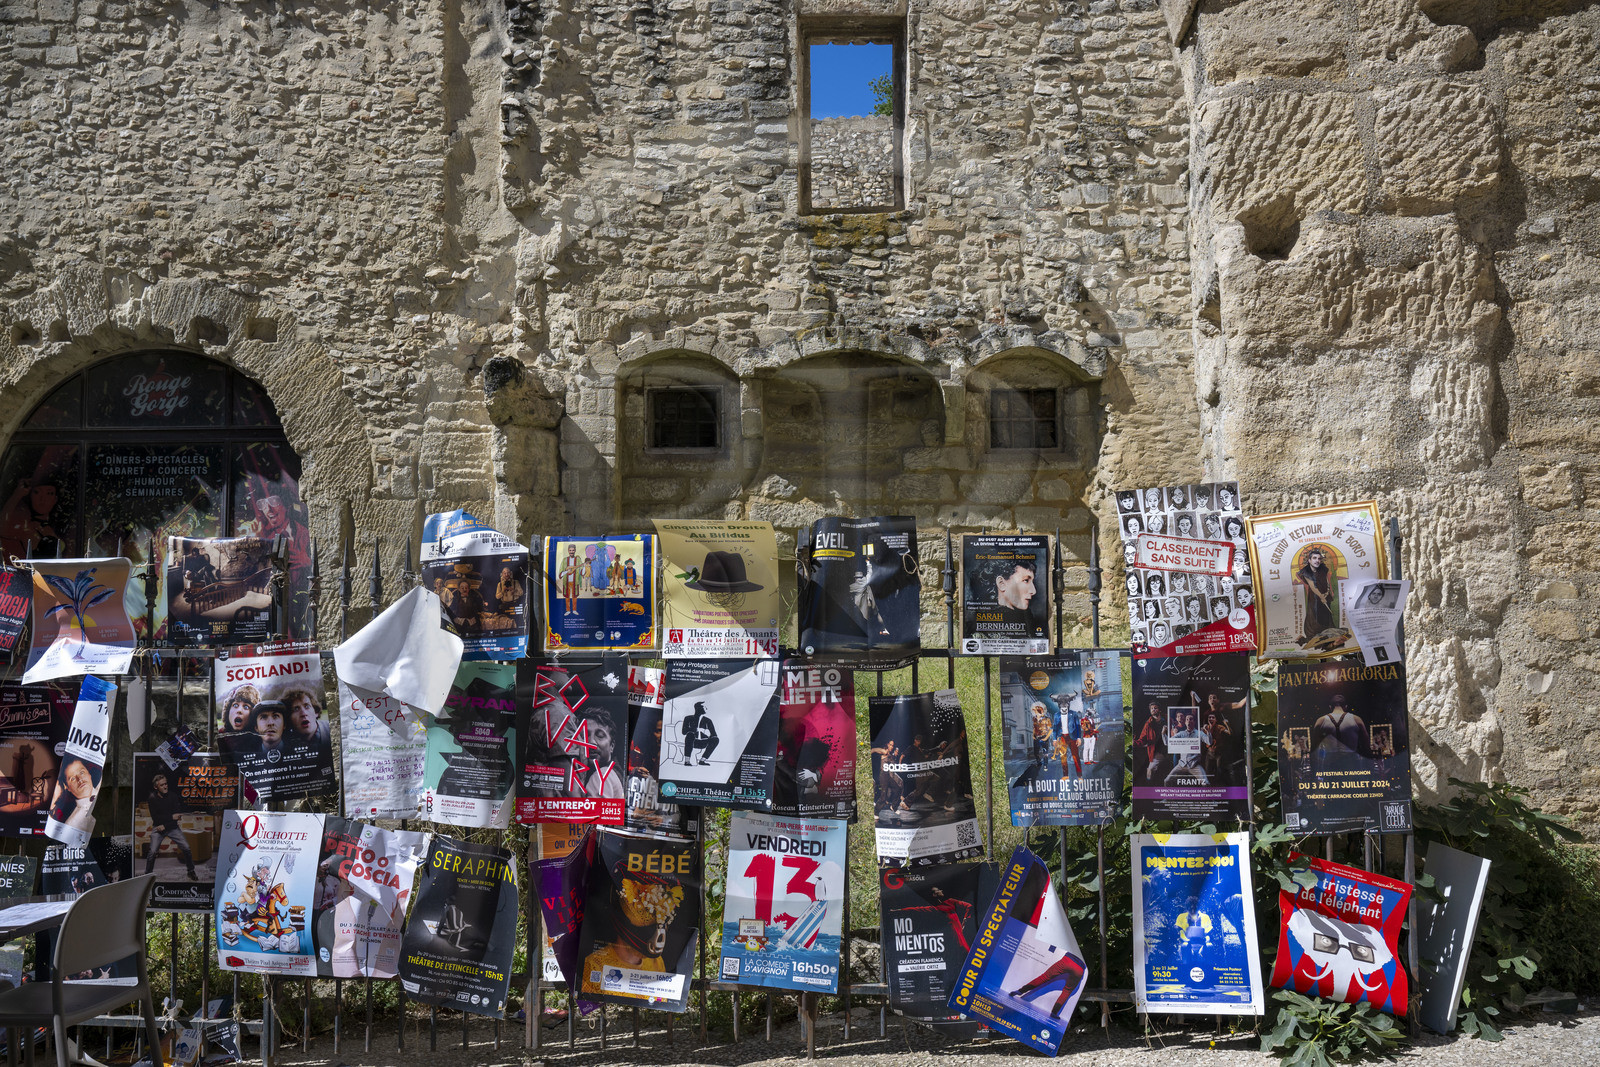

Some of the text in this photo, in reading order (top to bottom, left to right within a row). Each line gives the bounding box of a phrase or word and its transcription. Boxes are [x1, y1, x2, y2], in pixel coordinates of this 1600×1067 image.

[123, 375, 191, 397] Rouge
[130, 393, 189, 417] Gorge
[102, 466, 208, 475] CABARET CONCERTS
[134, 477, 175, 486] HUMOUR
[663, 525, 724, 533] Cinquième
[816, 530, 849, 549] ÉVEIL
[1146, 541, 1222, 558] CLASSEMENT
[1269, 524, 1366, 580] LE GRAND RETOUR DE BORIS
[1151, 553, 1216, 569] SANS SUITE
[976, 612, 1003, 620] SARAH
[976, 622, 1026, 630] BERNHARDT
[688, 628, 778, 638] Théâtre des Amants
[227, 661, 309, 682] SCOTLAND!
[673, 660, 719, 671] Willy Protagoras
[351, 696, 390, 711] C'EST
[0, 706, 49, 726] Bunny's Bar
[384, 709, 406, 725] ÇA
[474, 728, 491, 736] 5040
[188, 766, 228, 776] TOUTES
[178, 776, 240, 787] LES CHOSES
[1028, 777, 1112, 793] À BOUT DE SOUFFLE
[1177, 778, 1206, 786] FRANTZ
[1298, 779, 1391, 790] DU 3 AU 21 JUILLET 2024
[181, 785, 236, 797] GÉNIALES
[666, 784, 732, 797] ARCHIPEL Théâtre
[743, 787, 766, 798] 13h55
[1058, 791, 1115, 801] CLAUDE NOUGARO
[538, 798, 597, 812] L'ENTREPÔT
[601, 806, 621, 815] 16H15
[771, 802, 835, 812] Roseau Teinturiers
[775, 821, 829, 833] JEAN-PIERRE MARTINEZ
[323, 838, 376, 864] PETTO
[746, 832, 827, 857] VENDREDI
[63, 847, 85, 860] Birds
[433, 850, 517, 887] SERAPHIN
[627, 850, 692, 875] BÉBÉ
[1146, 856, 1235, 869] MENTEZ-MOI
[338, 859, 400, 890] COSCIA
[743, 852, 823, 932] 13
[1322, 877, 1385, 905] tristesse
[1301, 889, 1381, 920] de l'éléphant
[894, 918, 913, 935] MO
[373, 930, 400, 939] D'ENCRE
[956, 969, 979, 1007] COUR
[971, 948, 987, 969] DU
[980, 863, 1026, 948] SPECTATEUR
[895, 933, 946, 955] MENTOS
[744, 958, 755, 966] LA
[791, 960, 830, 975] 16h50
[899, 956, 944, 966] CRÉATION FLAMENCA
[408, 955, 504, 983] THÉÂTRE DE L'ETINCELLE 15h15
[744, 965, 788, 977] D'AVIGNON
[656, 974, 673, 983] 16h05
[972, 998, 992, 1012] 10H10
